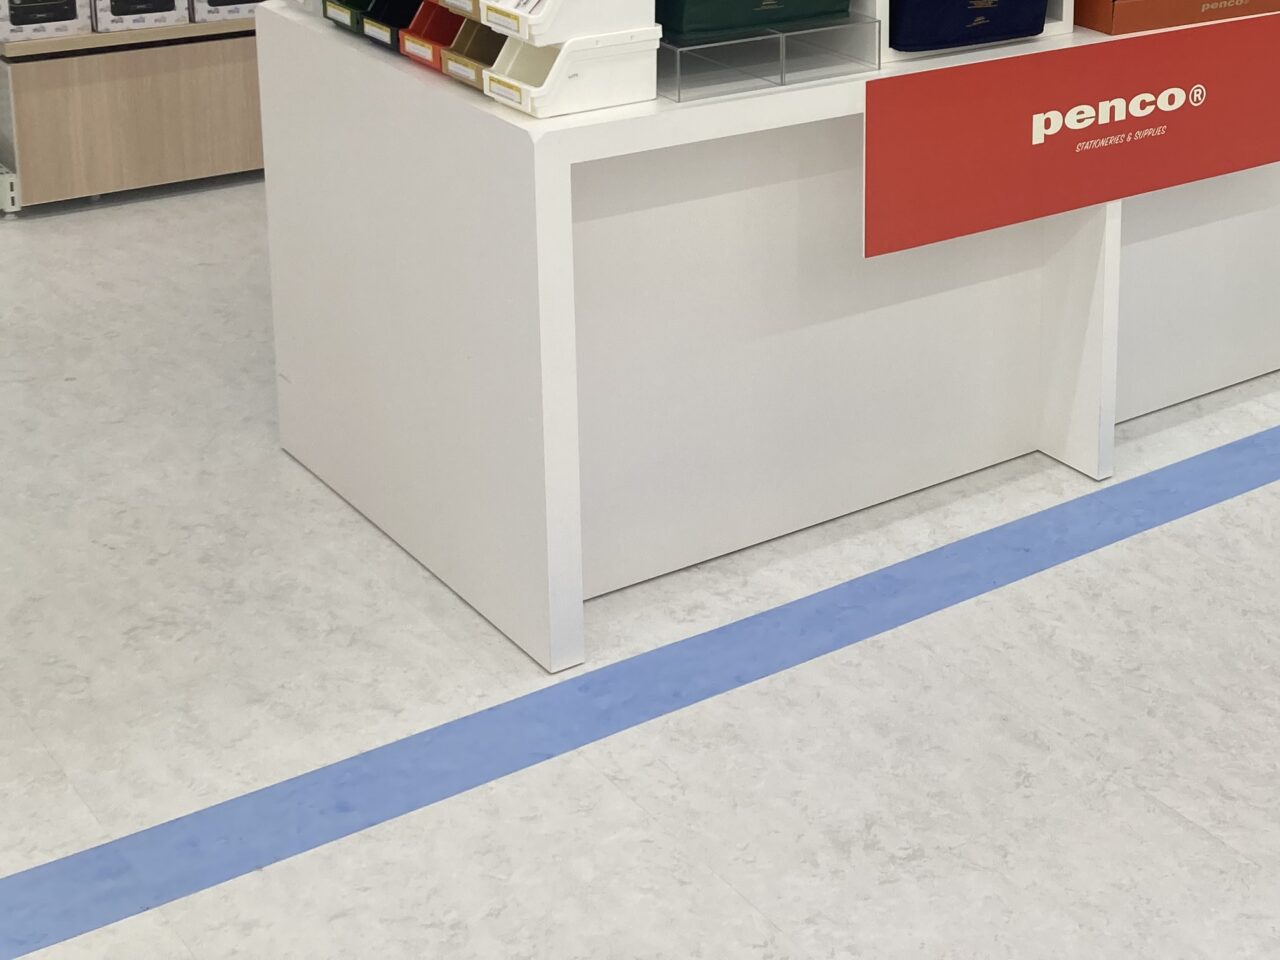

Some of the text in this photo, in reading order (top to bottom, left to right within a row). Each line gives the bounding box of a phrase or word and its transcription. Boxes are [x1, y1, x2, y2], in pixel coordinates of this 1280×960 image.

[1030, 83, 1207, 146] penco®
[1075, 124, 1168, 153] STATIONERIES & SUPPLIES
